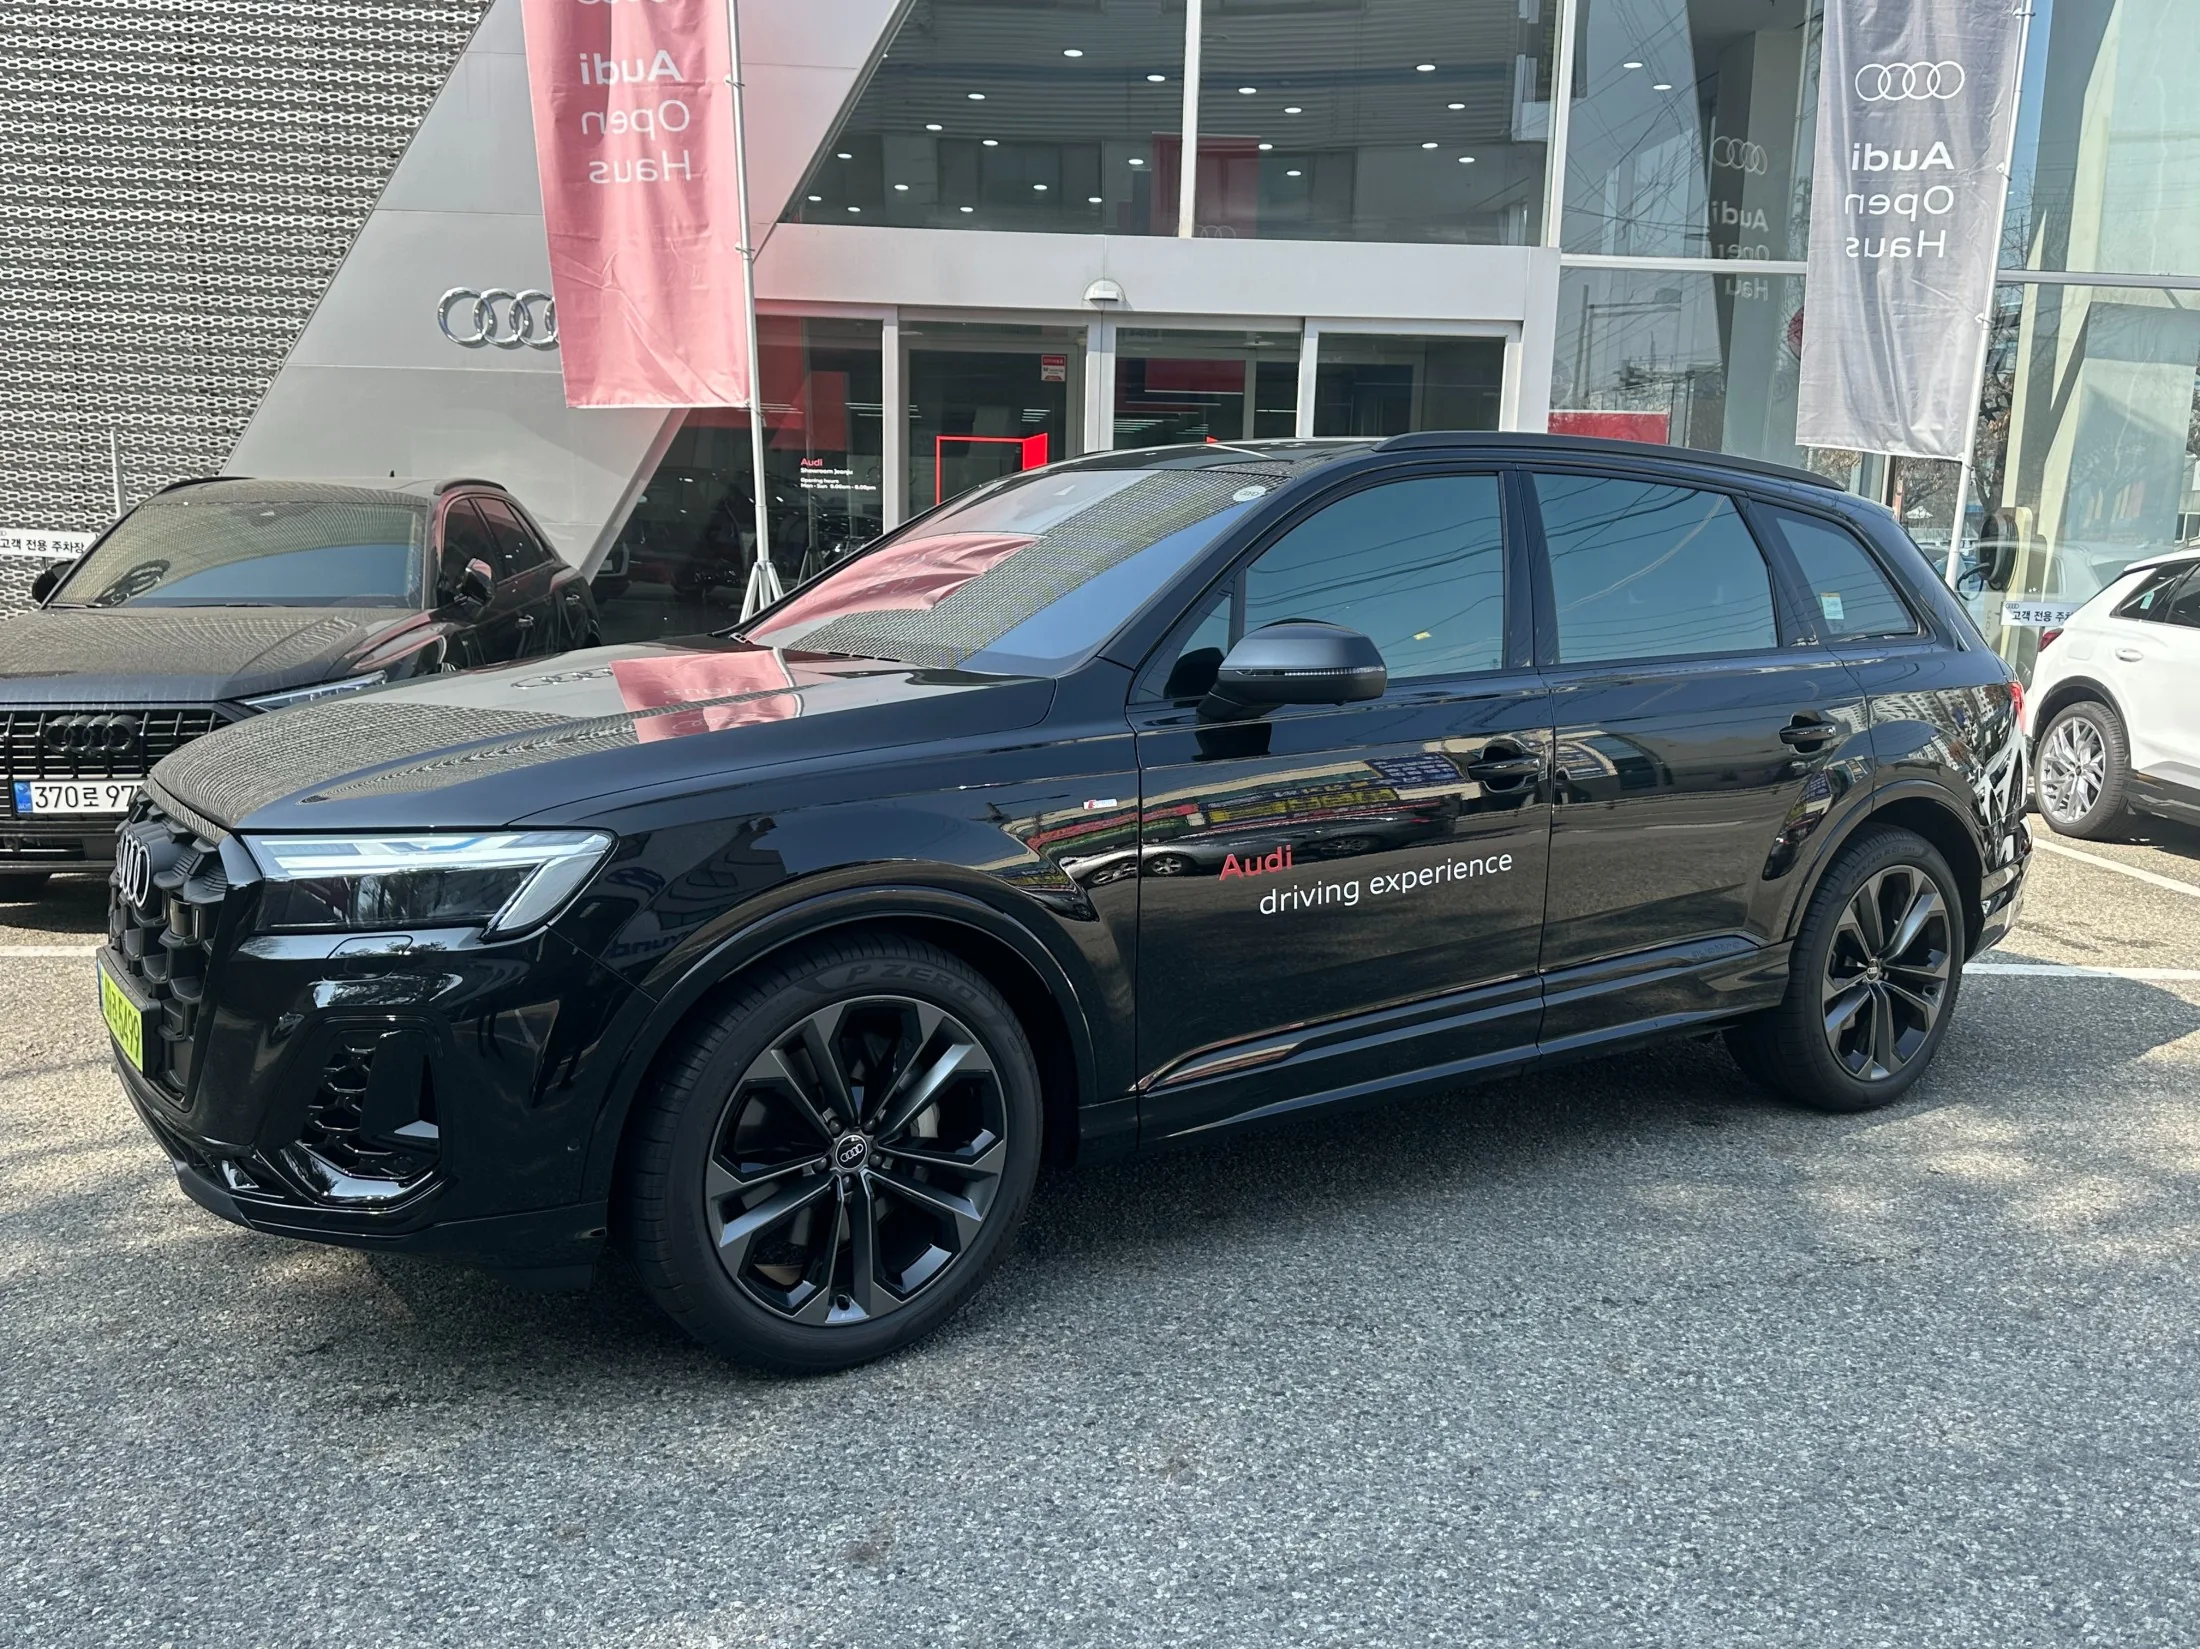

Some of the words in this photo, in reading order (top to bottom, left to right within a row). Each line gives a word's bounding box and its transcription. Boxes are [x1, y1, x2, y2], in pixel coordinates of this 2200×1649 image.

[800, 457, 823, 467] Audi
[0, 538, 21, 550] 고객
[26, 539, 47, 551] 전용
[51, 540, 85, 554] 주차장
[2012, 610, 2031, 622] 고객
[2034, 610, 2052, 622] 전용
[34, 785, 100, 809] 370로
[105, 784, 142, 808] 97
[1218, 843, 1293, 881] Audi
[1259, 878, 1360, 915] driving
[1369, 853, 1513, 894] experience
